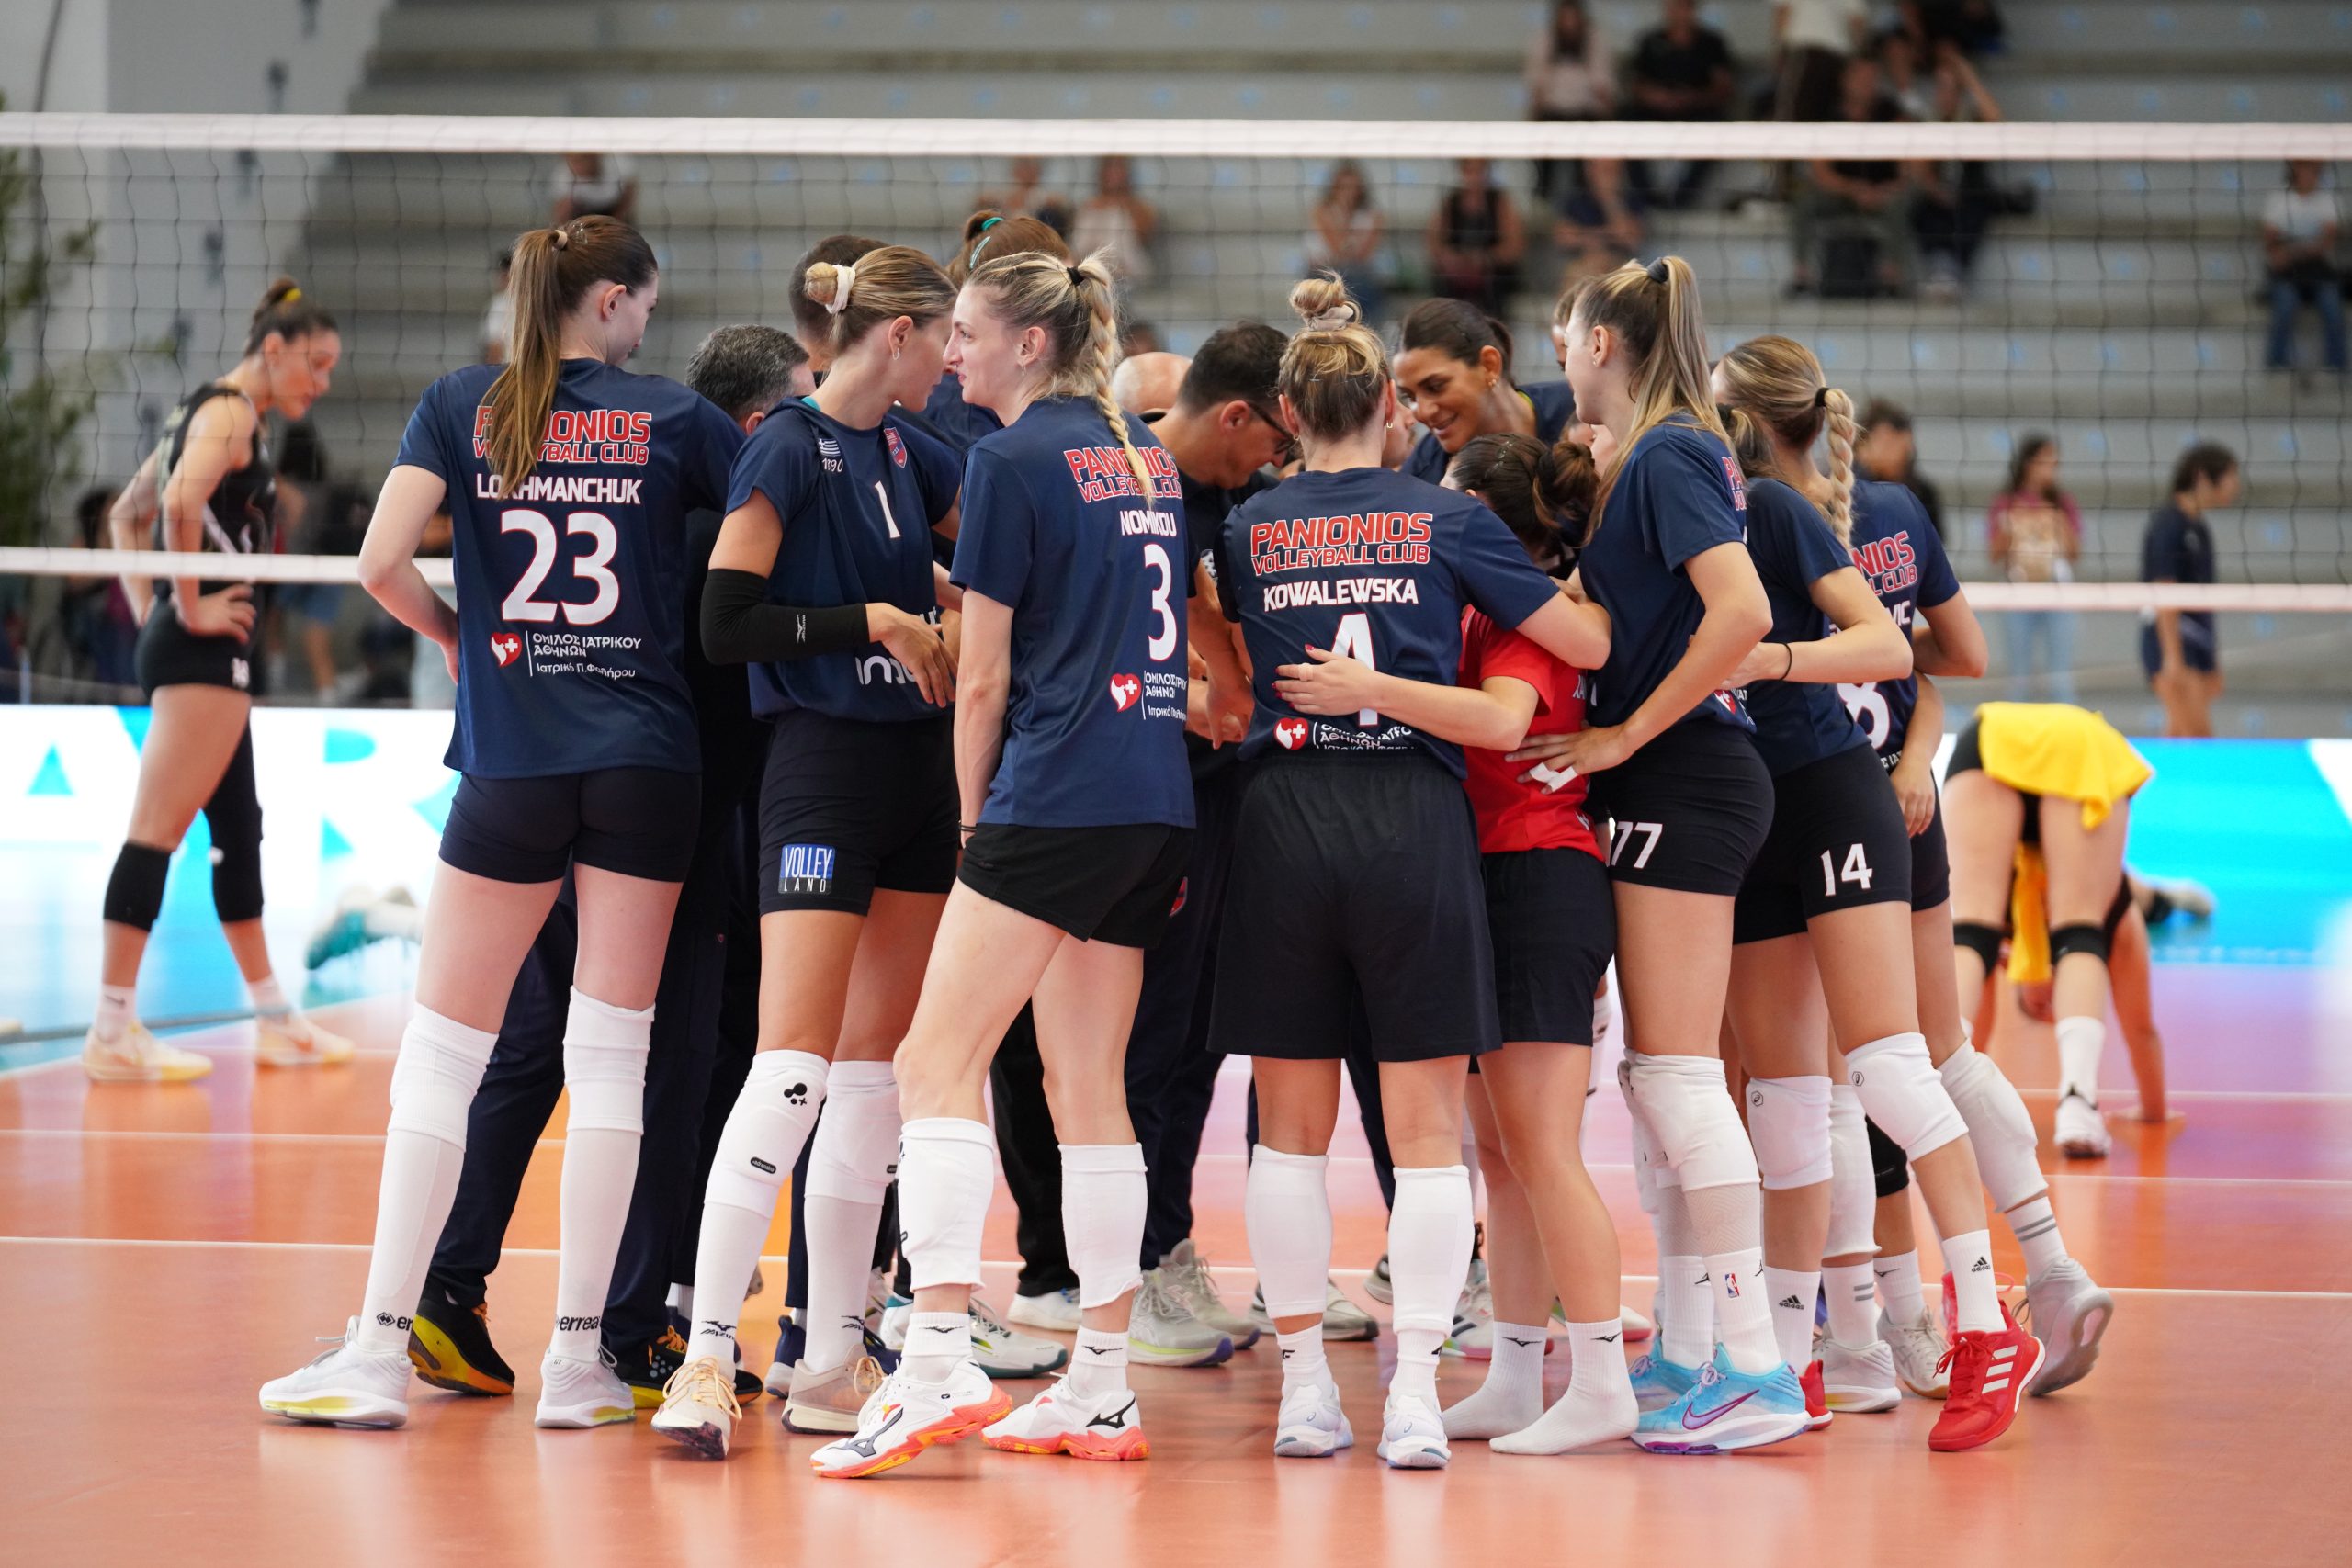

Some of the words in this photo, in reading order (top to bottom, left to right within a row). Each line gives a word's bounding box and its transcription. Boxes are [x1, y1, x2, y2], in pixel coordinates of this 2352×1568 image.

[600, 444, 649, 466] CLUB
[476, 473, 644, 504] LOHMANCHUK
[1078, 477, 1163, 503] VOLLEYBL
[875, 480, 900, 538] 1
[1120, 510, 1177, 536] NOMIKOU
[1251, 512, 1433, 557] PANIONIOS
[501, 509, 619, 626] 23
[1251, 545, 1375, 576] VOLLEYBALL
[1377, 544, 1430, 564] CLUB
[1882, 564, 1917, 593] CLUB
[1144, 543, 1178, 661] 3
[1263, 578, 1419, 612] KOWALEWSKA
[1146, 685, 1175, 698] ΑΘΗΝΩ
[1611, 821, 1663, 869] 77
[785, 847, 833, 879] VOLLEY
[1820, 843, 1873, 897] 14
[784, 877, 827, 893] LAND
